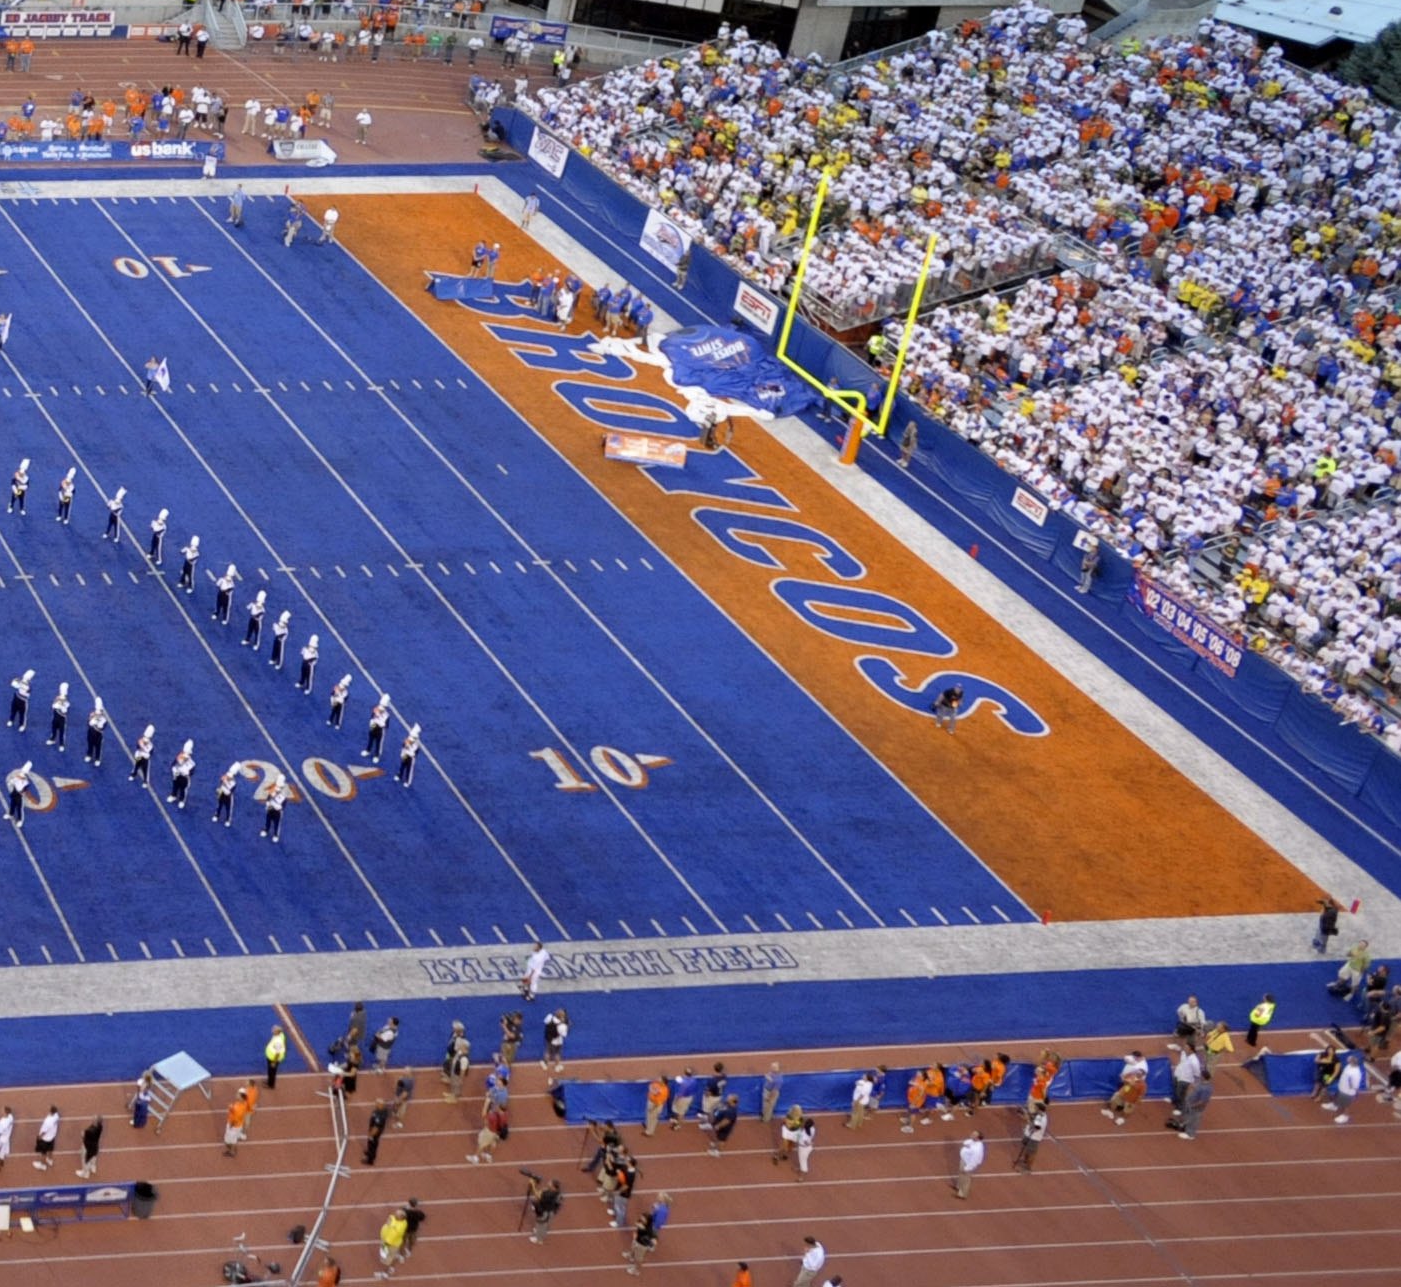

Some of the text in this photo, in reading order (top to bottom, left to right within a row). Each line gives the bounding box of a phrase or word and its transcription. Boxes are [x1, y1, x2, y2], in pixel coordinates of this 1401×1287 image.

[72, 13, 110, 23] TRACK
[114, 256, 193, 279] 10
[740, 290, 773, 320] ESPN
[425, 270, 1050, 737] BRONCOS
[1017, 492, 1044, 520] ESPN
[1161, 600, 1176, 620] '03
[1177, 611, 1191, 632] '04
[1192, 622, 1208, 643] '05
[1208, 632, 1224, 656] '06
[242, 756, 358, 802] 20
[530, 745, 650, 792] 10
[419, 944, 799, 984] LYLE SMITH FIELD
